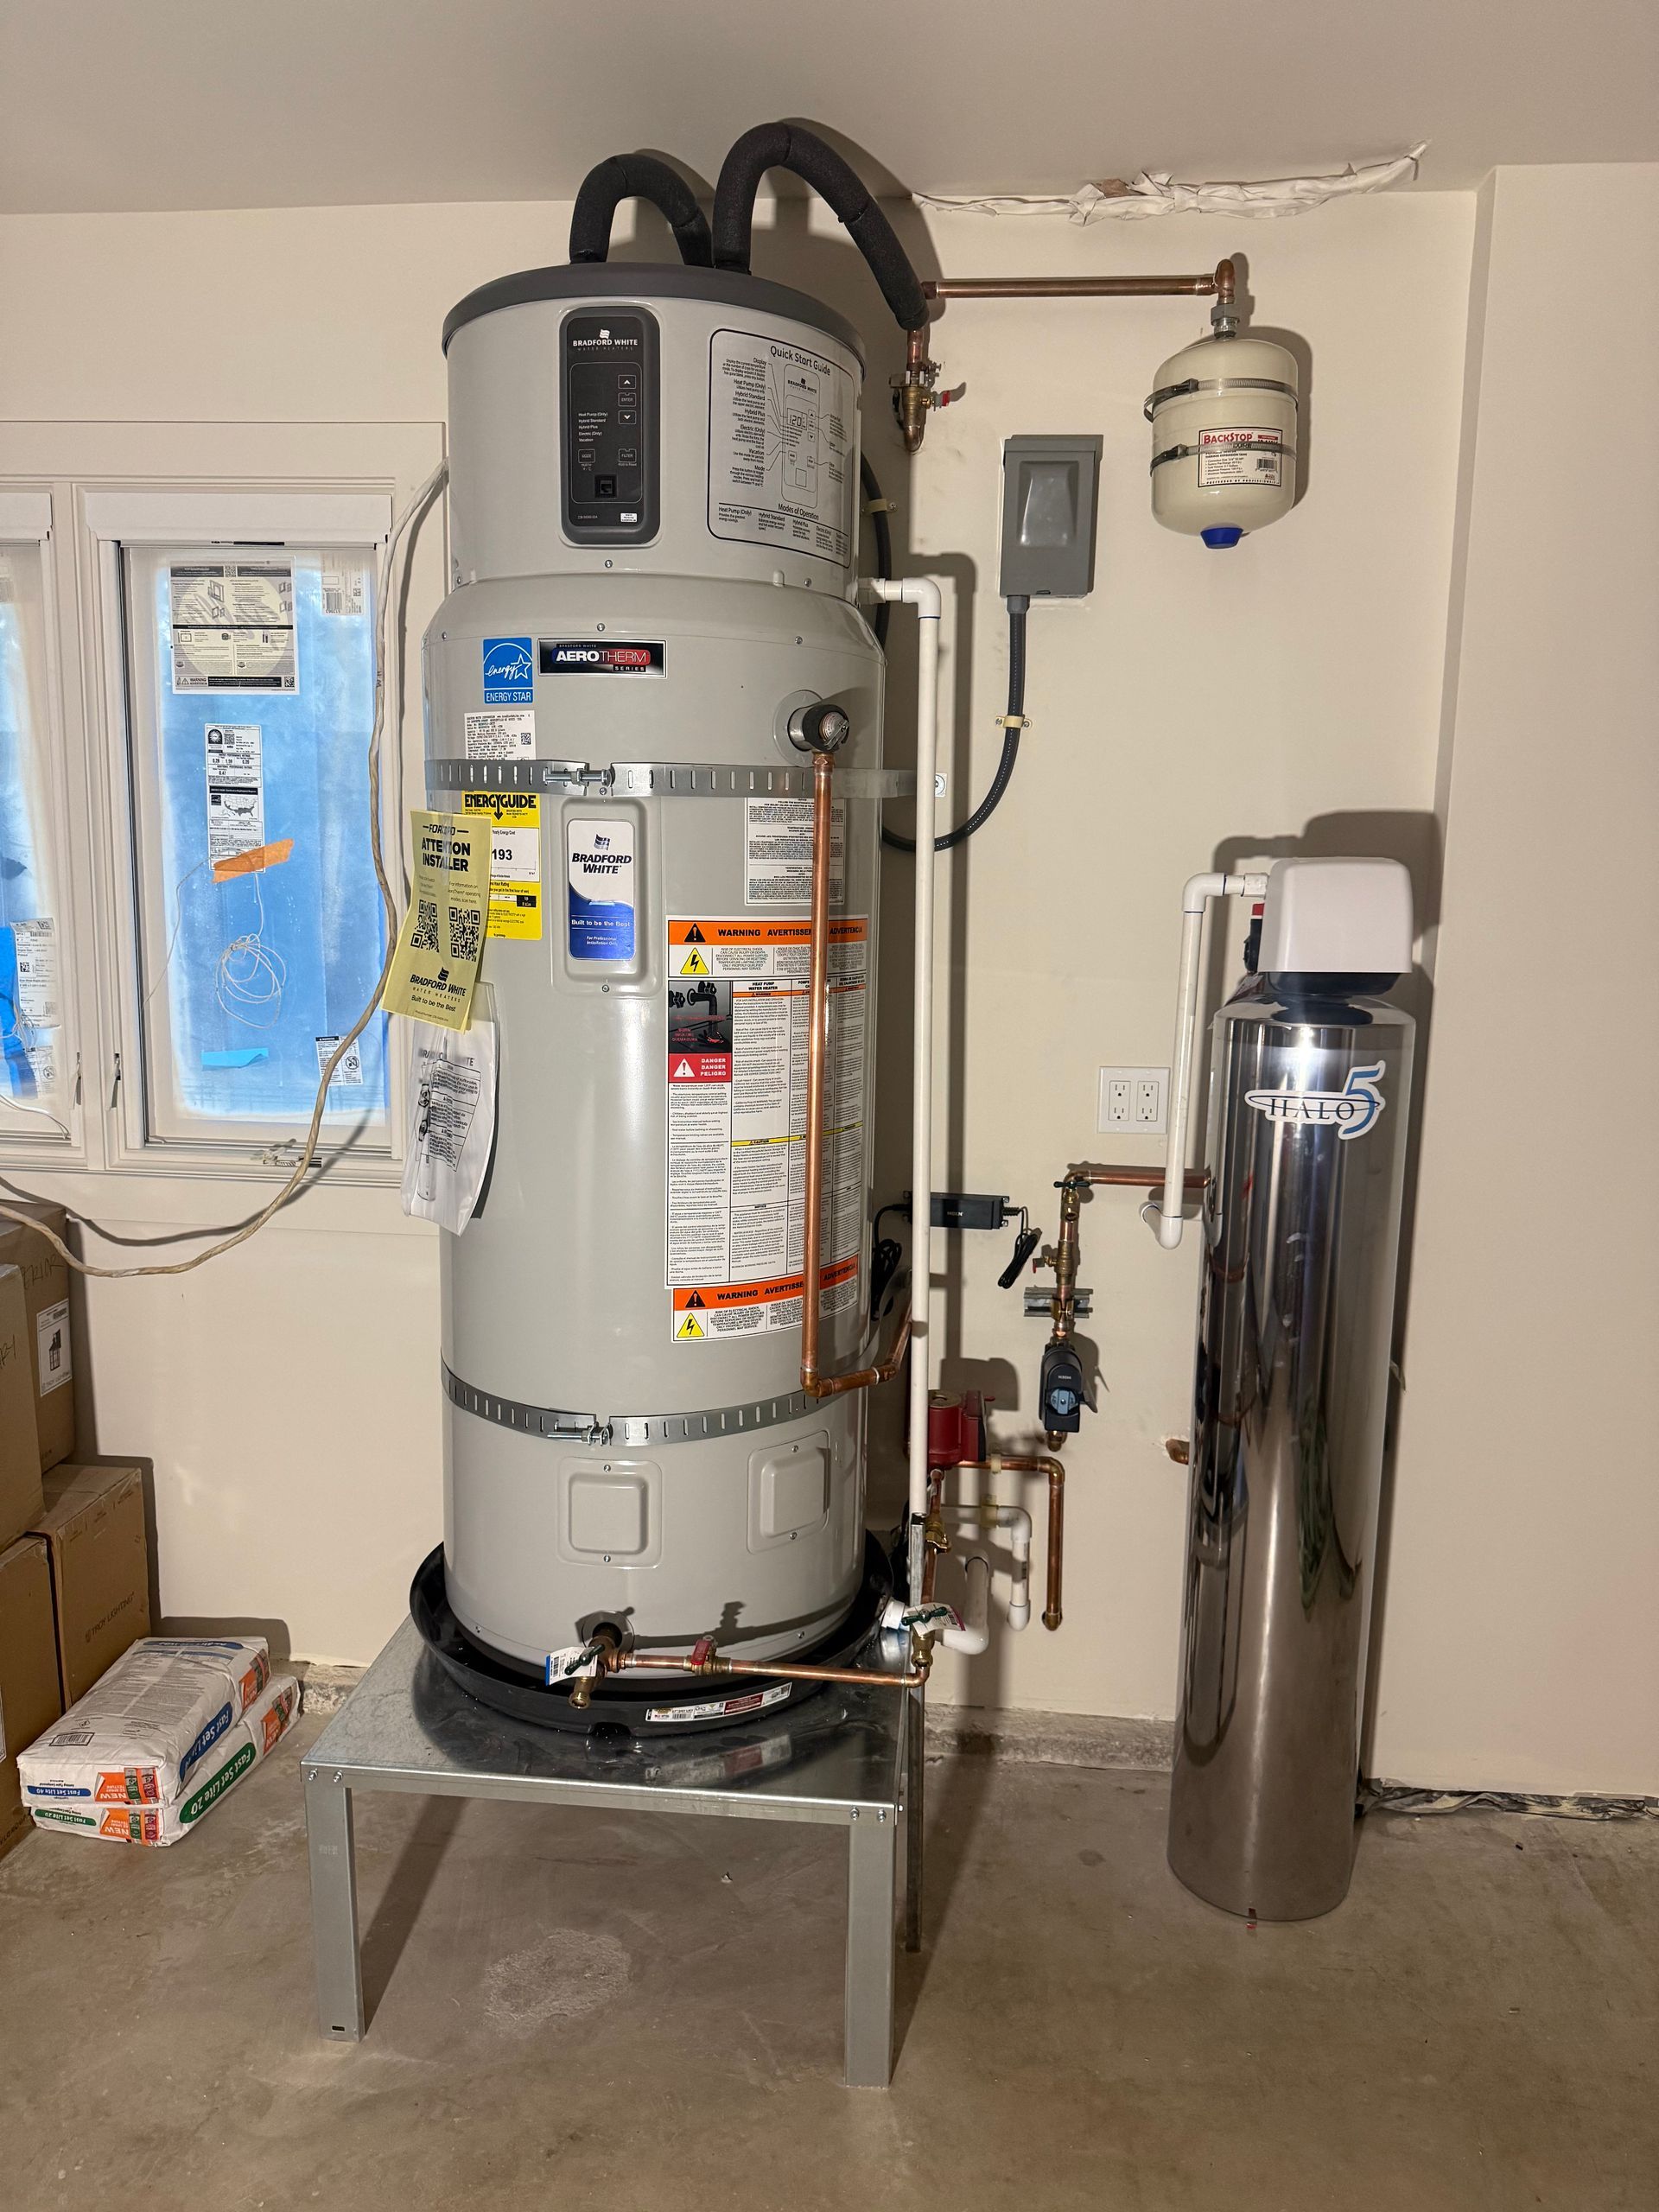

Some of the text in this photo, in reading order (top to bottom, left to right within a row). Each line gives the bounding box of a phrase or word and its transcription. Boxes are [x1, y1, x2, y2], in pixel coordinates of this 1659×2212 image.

[770, 346, 831, 376] Quick Start Guide
[788, 380, 807, 390] BRADFORD
[1204, 433, 1252, 445] BACKSTOP
[770, 514, 785, 522] Standard
[778, 503, 793, 514] Modes
[800, 509, 819, 521] Operation
[556, 650, 647, 663] AEROTHERM
[485, 664, 517, 680] energy
[486, 691, 531, 702] ENERGY STAR
[464, 794, 537, 808] ENERGYGUIDE
[492, 849, 512, 861] 193
[572, 853, 632, 864] BRADFORD
[583, 863, 620, 874] WHITE
[410, 974, 467, 997] BRADFORD WHITE
[435, 993, 461, 1003] HEATERS
[445, 1004, 456, 1012] Best
[1270, 1068, 1381, 1135] HALO 5
[717, 1290, 758, 1300] WARNING
[92, 1592, 134, 1636] TROY LIGHTING
[217, 1710, 229, 1732] Fast
[202, 1726, 216, 1746] Set
[191, 1749, 251, 1815] Fast Set Lite 20
[105, 1826, 129, 1836] NEW
